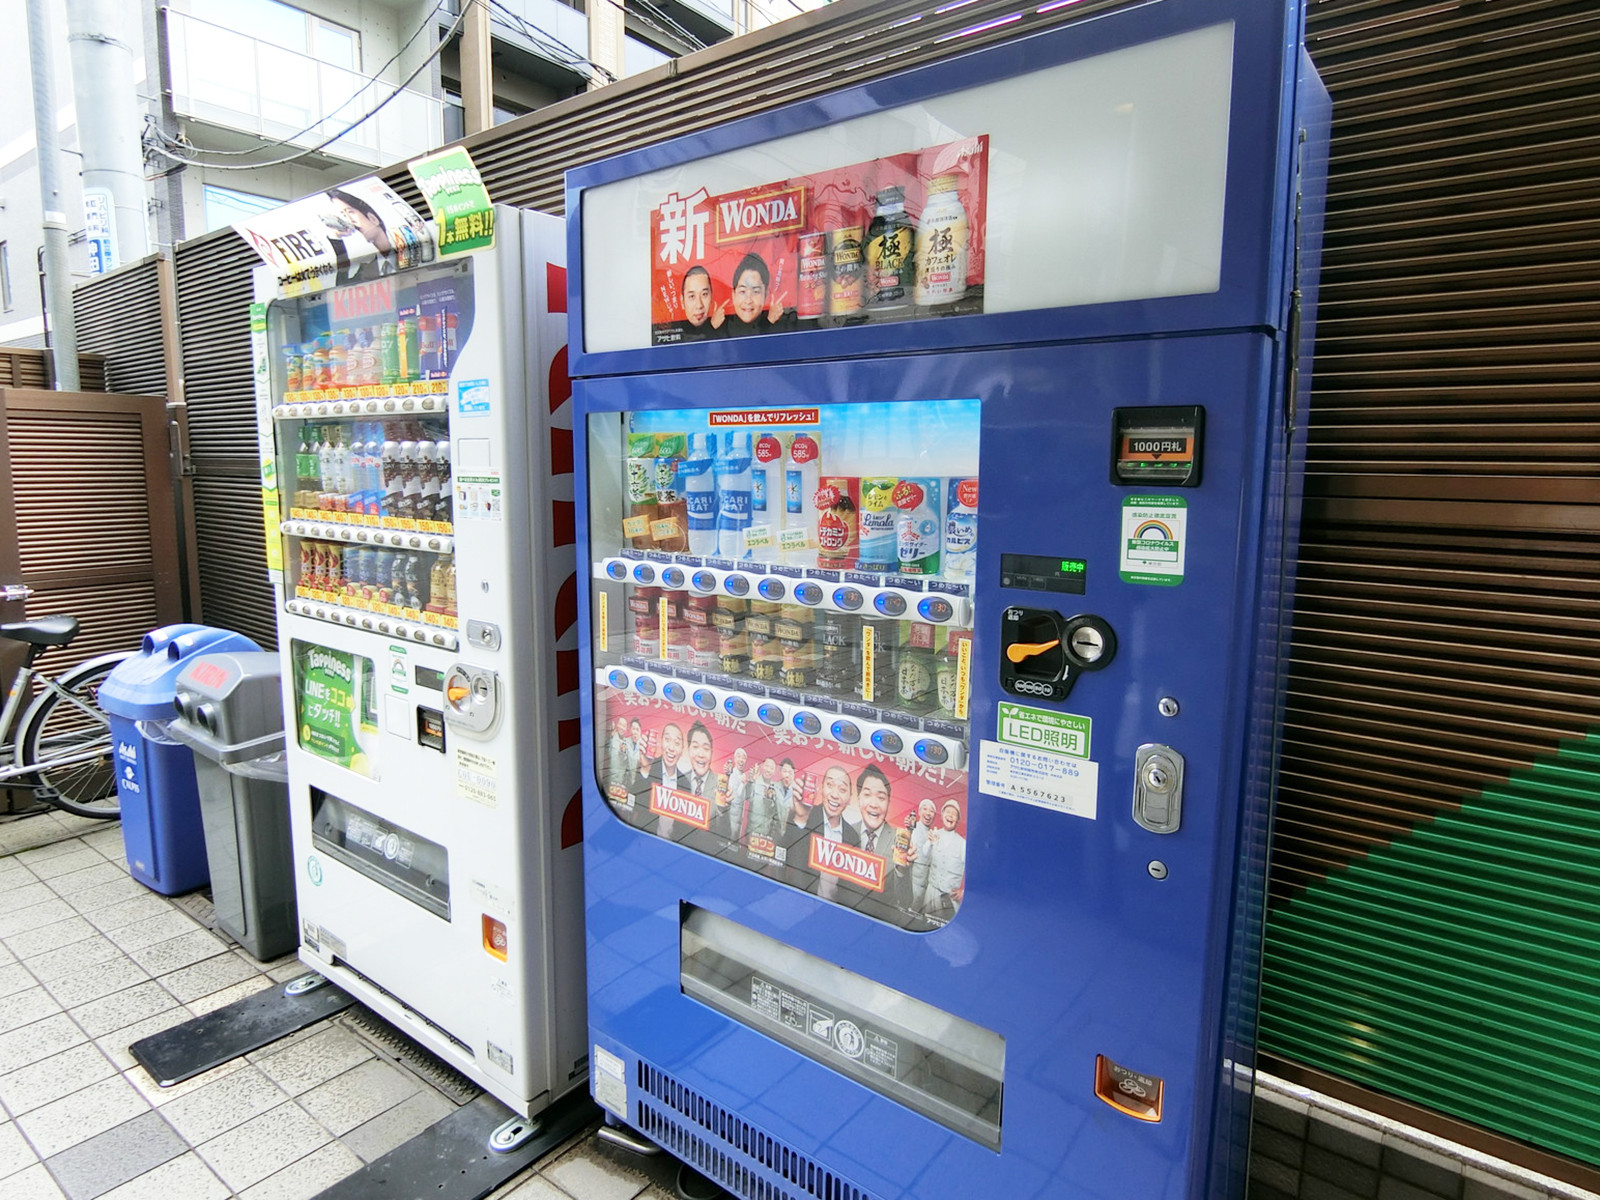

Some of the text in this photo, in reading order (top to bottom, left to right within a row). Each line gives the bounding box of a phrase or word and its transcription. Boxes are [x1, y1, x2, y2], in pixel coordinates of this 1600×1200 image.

[660, 190, 710, 265] 新
[720, 196, 797, 235] WONDA
[271, 229, 325, 264] FIRE
[877, 233, 902, 260] 極
[928, 227, 954, 255] 極
[925, 254, 957, 267] カフェオレ
[333, 280, 393, 320] KIRIN
[1134, 441, 1182, 452] 1000円札
[900, 548, 926, 559] ゼリー
[1061, 561, 1084, 572] 販売中
[683, 609, 704, 620] WONDA
[747, 619, 768, 630] WONDA
[777, 626, 799, 636] WONDA
[823, 634, 846, 645] LACK
[308, 649, 352, 683] Tappiness
[1009, 723, 1078, 751] LED照明
[1010, 757, 1080, 777] 0120-017-889
[655, 785, 705, 821] WONDA
[815, 837, 877, 881] WONDA
